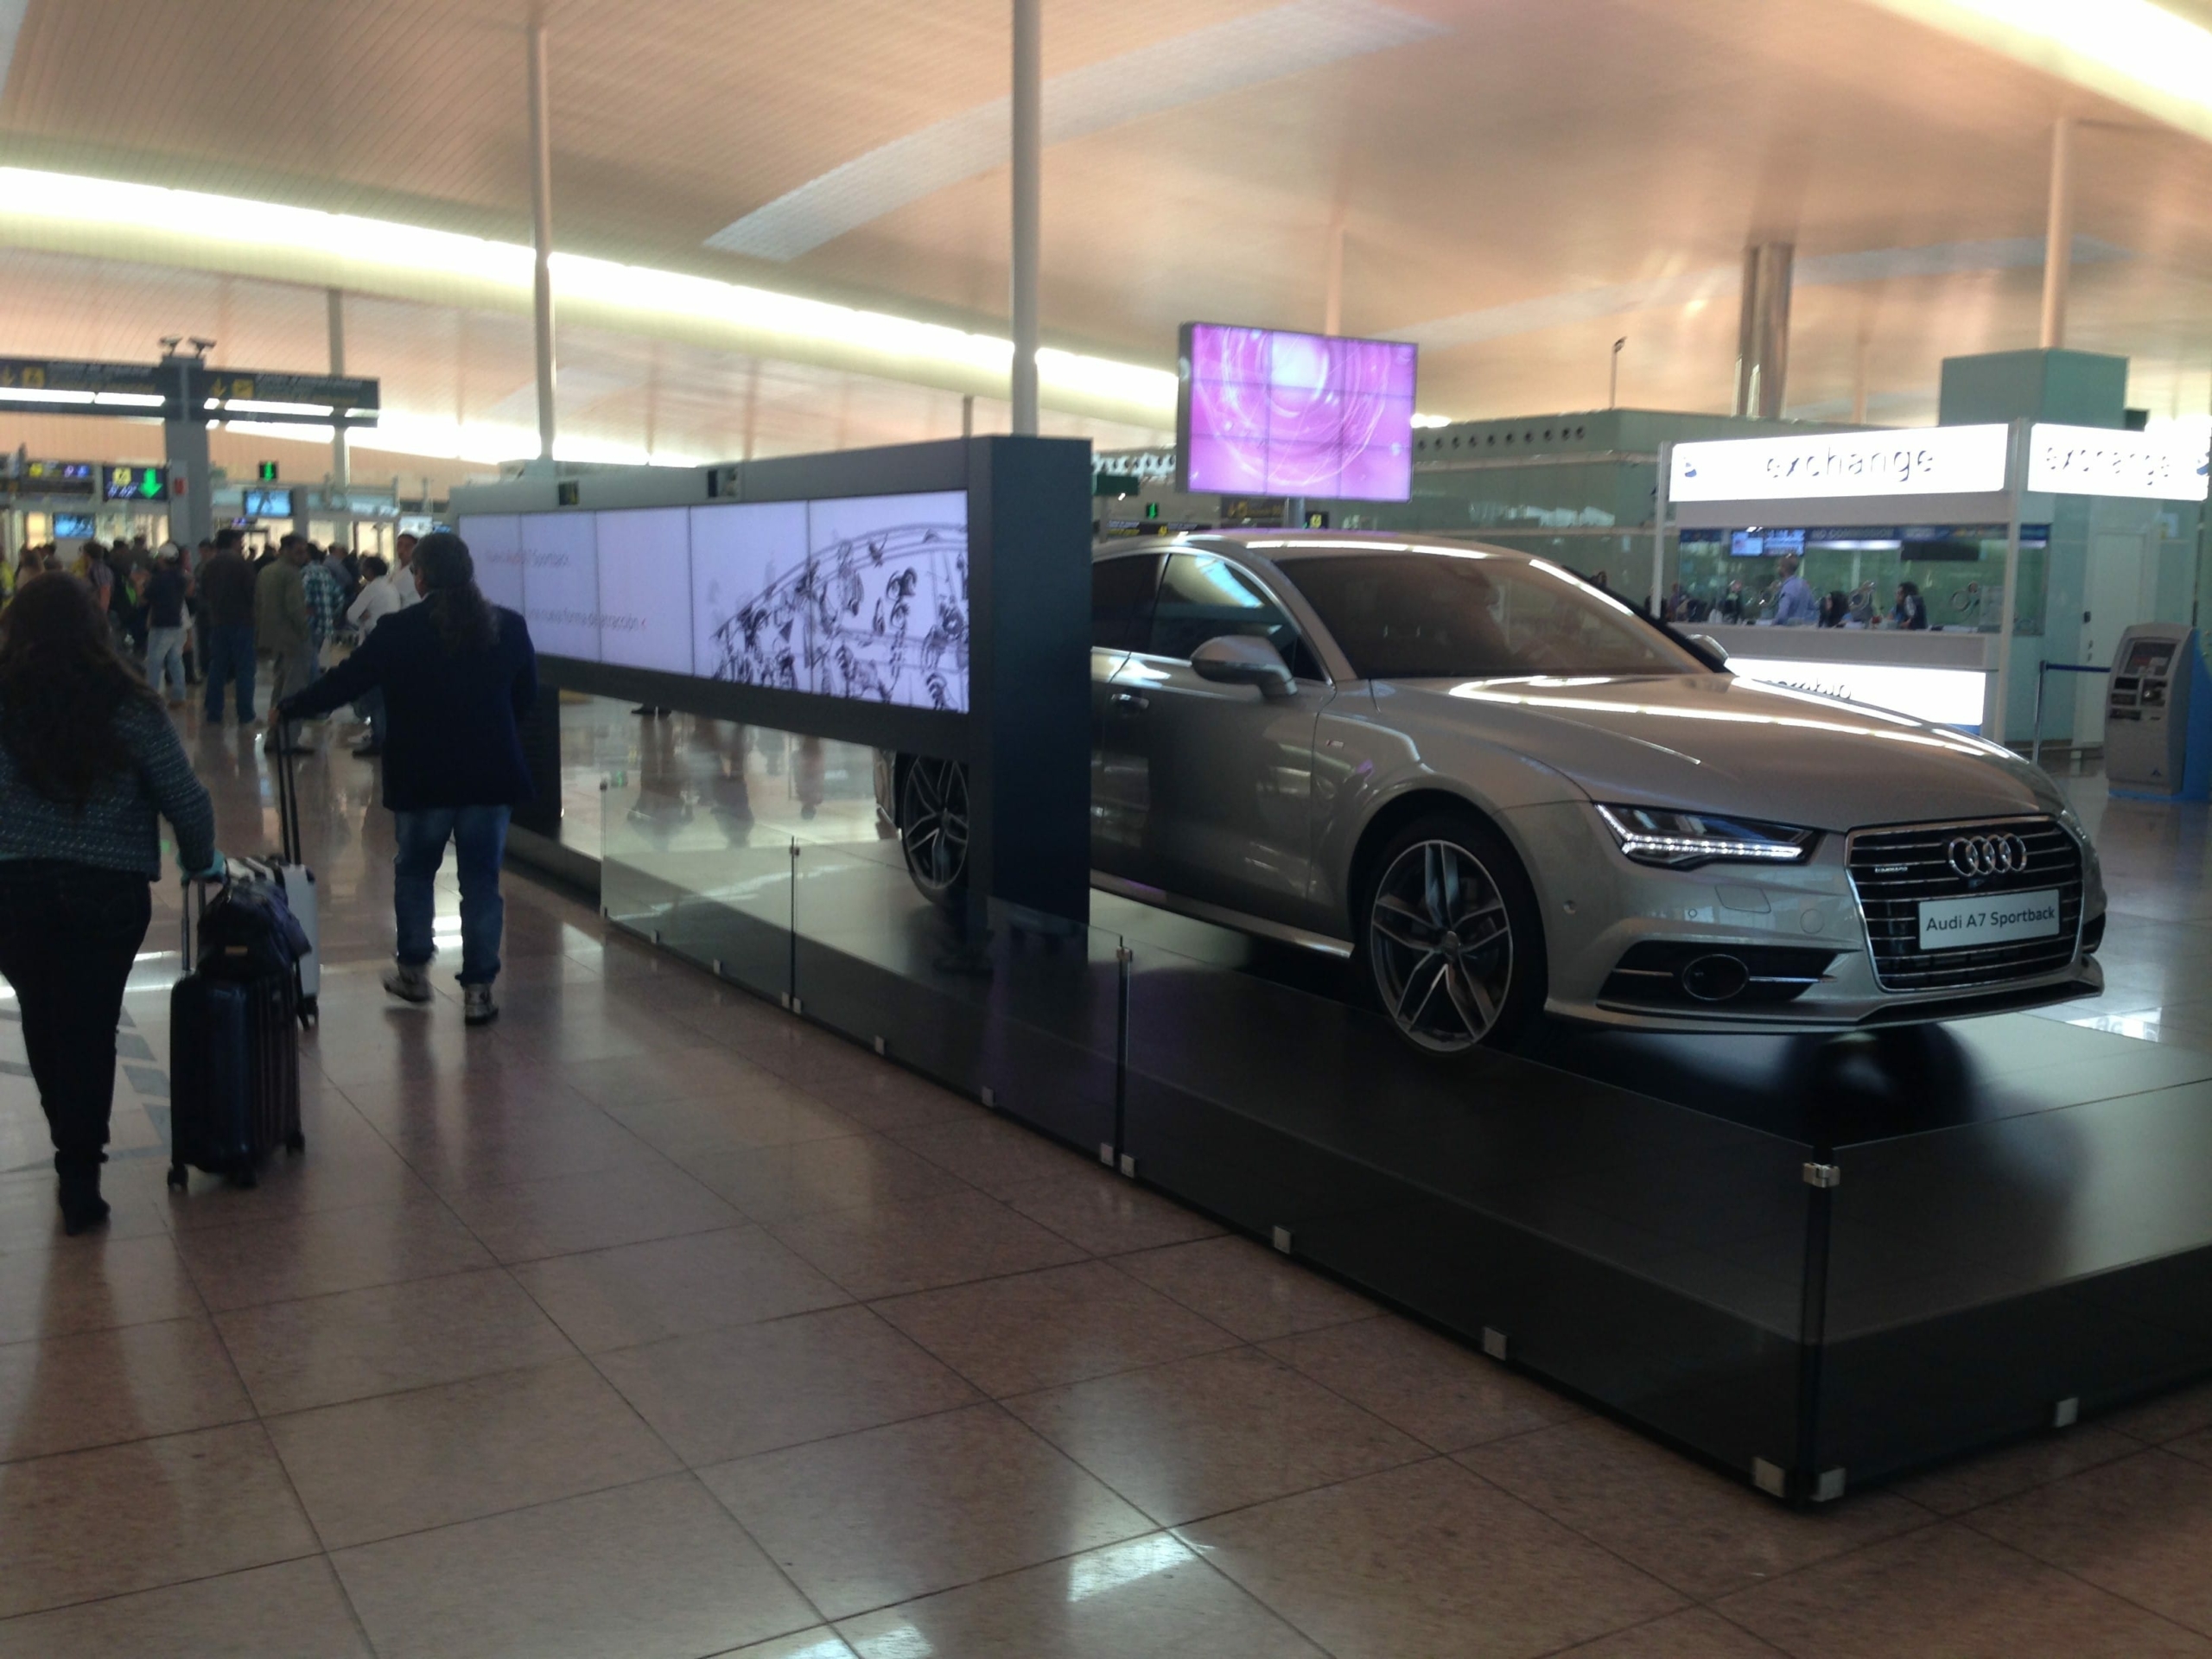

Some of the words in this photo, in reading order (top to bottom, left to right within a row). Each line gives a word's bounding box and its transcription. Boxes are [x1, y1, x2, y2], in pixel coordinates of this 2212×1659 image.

[1766, 445, 1933, 482] exchange
[2046, 445, 2170, 486] exchange
[1926, 915, 1962, 931] Audi
[1966, 912, 1986, 927] A7
[1990, 906, 2056, 927] Sportback
